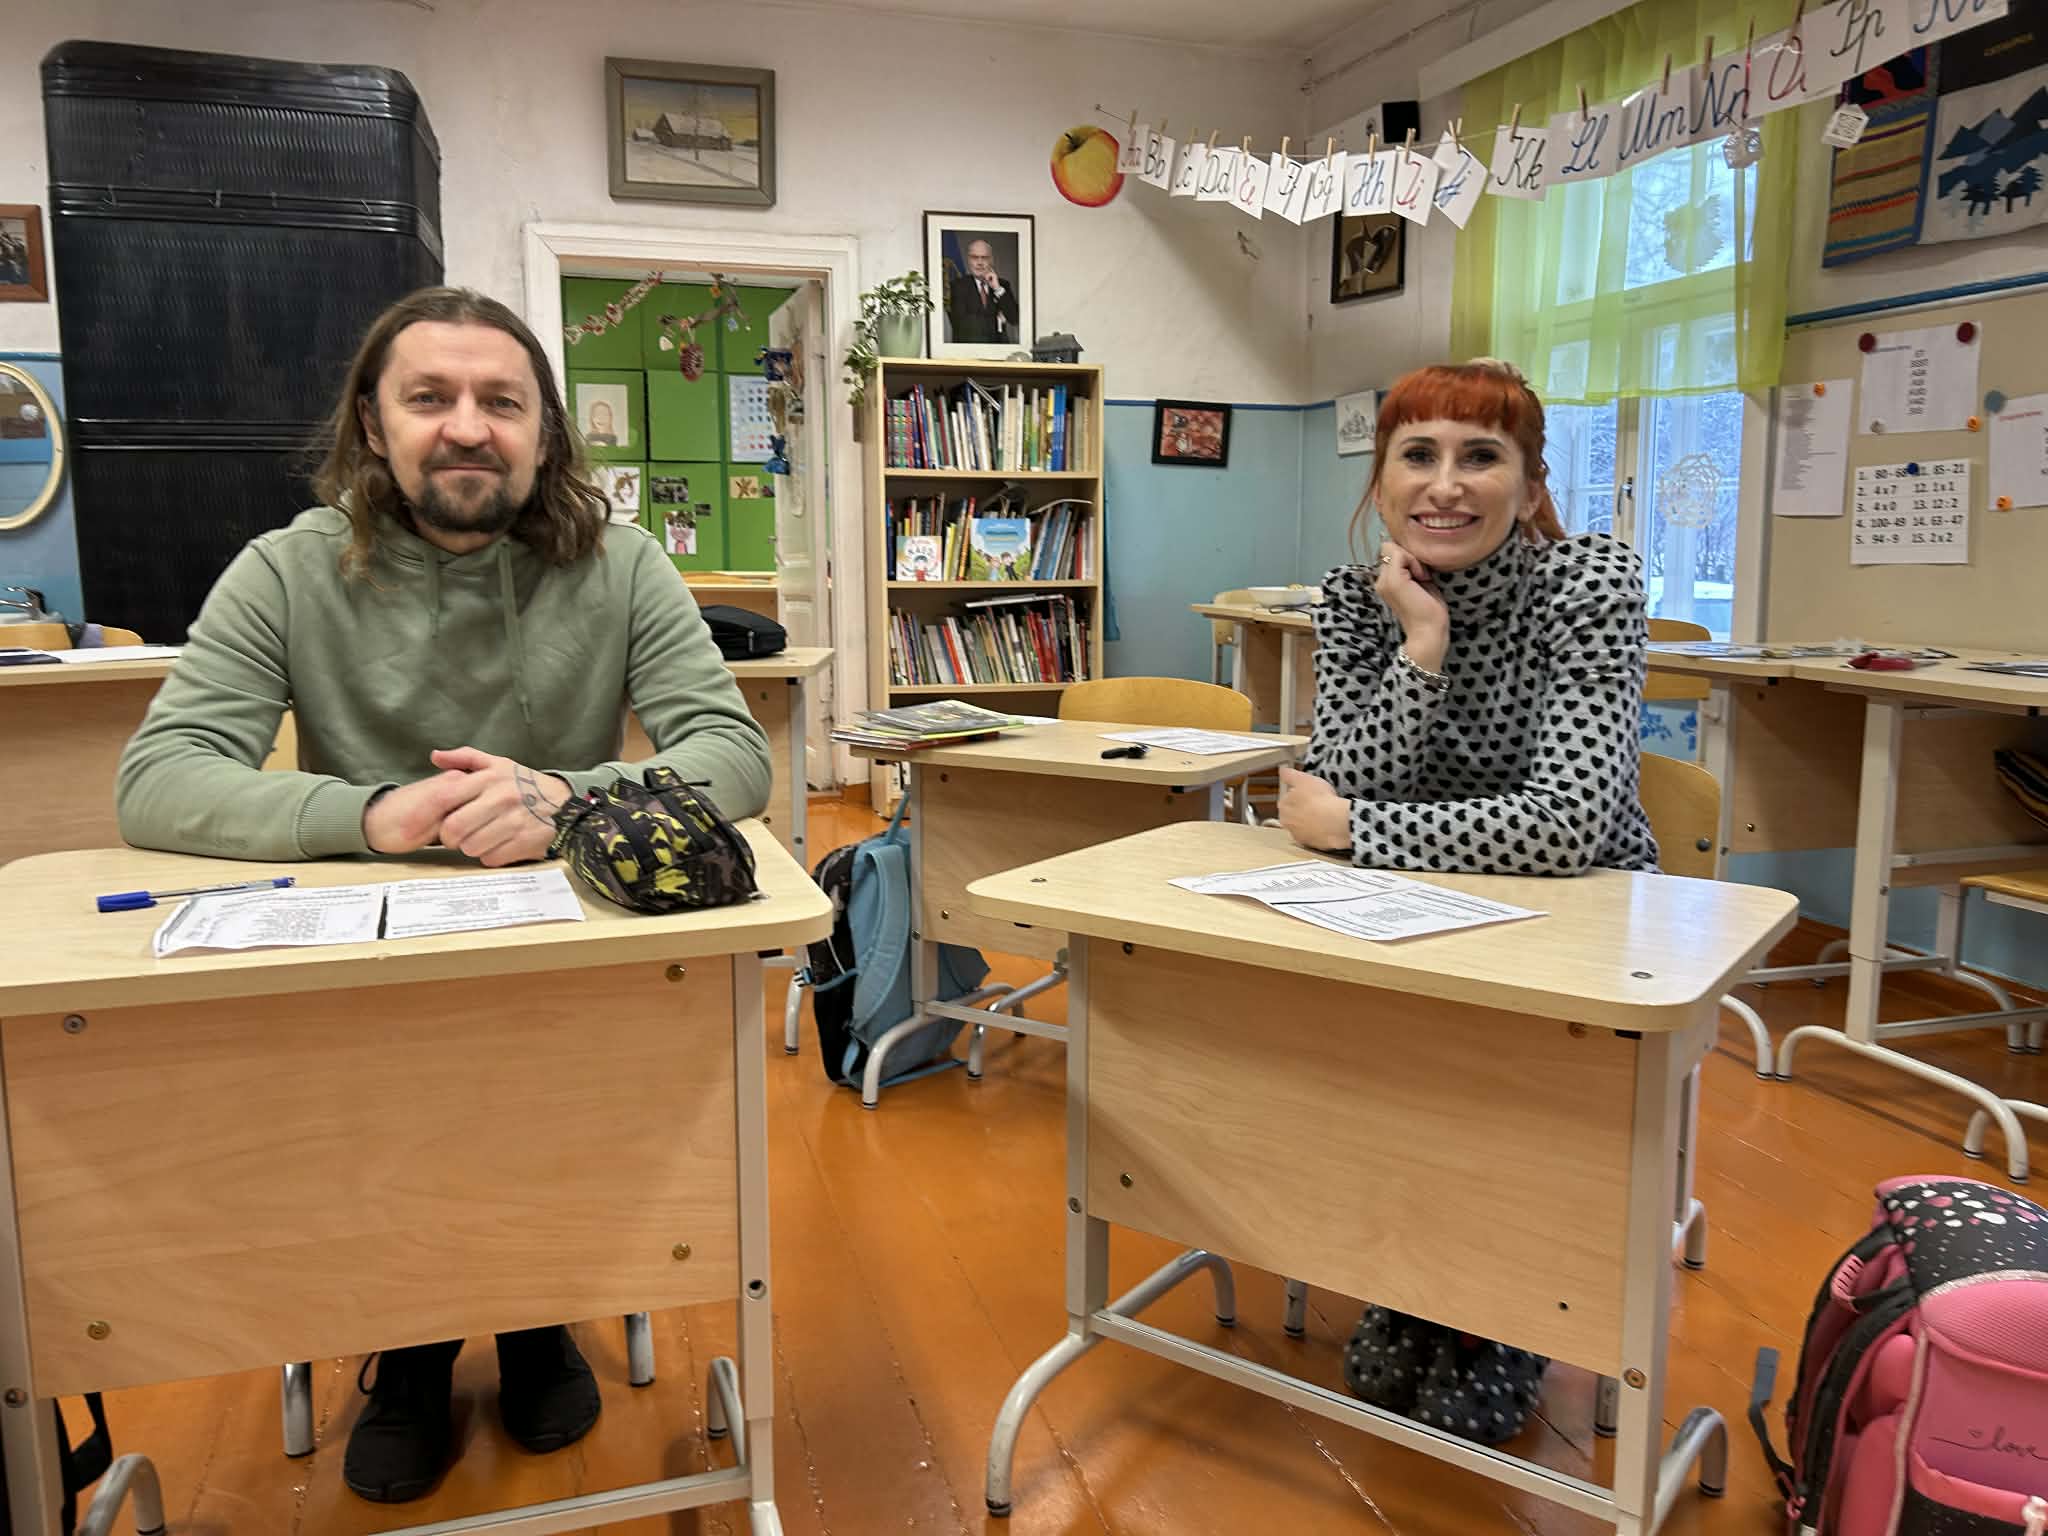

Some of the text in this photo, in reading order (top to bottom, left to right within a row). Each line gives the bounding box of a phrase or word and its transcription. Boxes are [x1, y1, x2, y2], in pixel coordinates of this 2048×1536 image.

[1199, 153, 1237, 193] Dd
[1351, 159, 1386, 207] Hh
[1497, 135, 1546, 190] Kk
[1561, 113, 1609, 174] Ll
[1617, 92, 1686, 161] Mm
[1689, 63, 1749, 134] Nn
[1990, 1424, 2037, 1458] love
